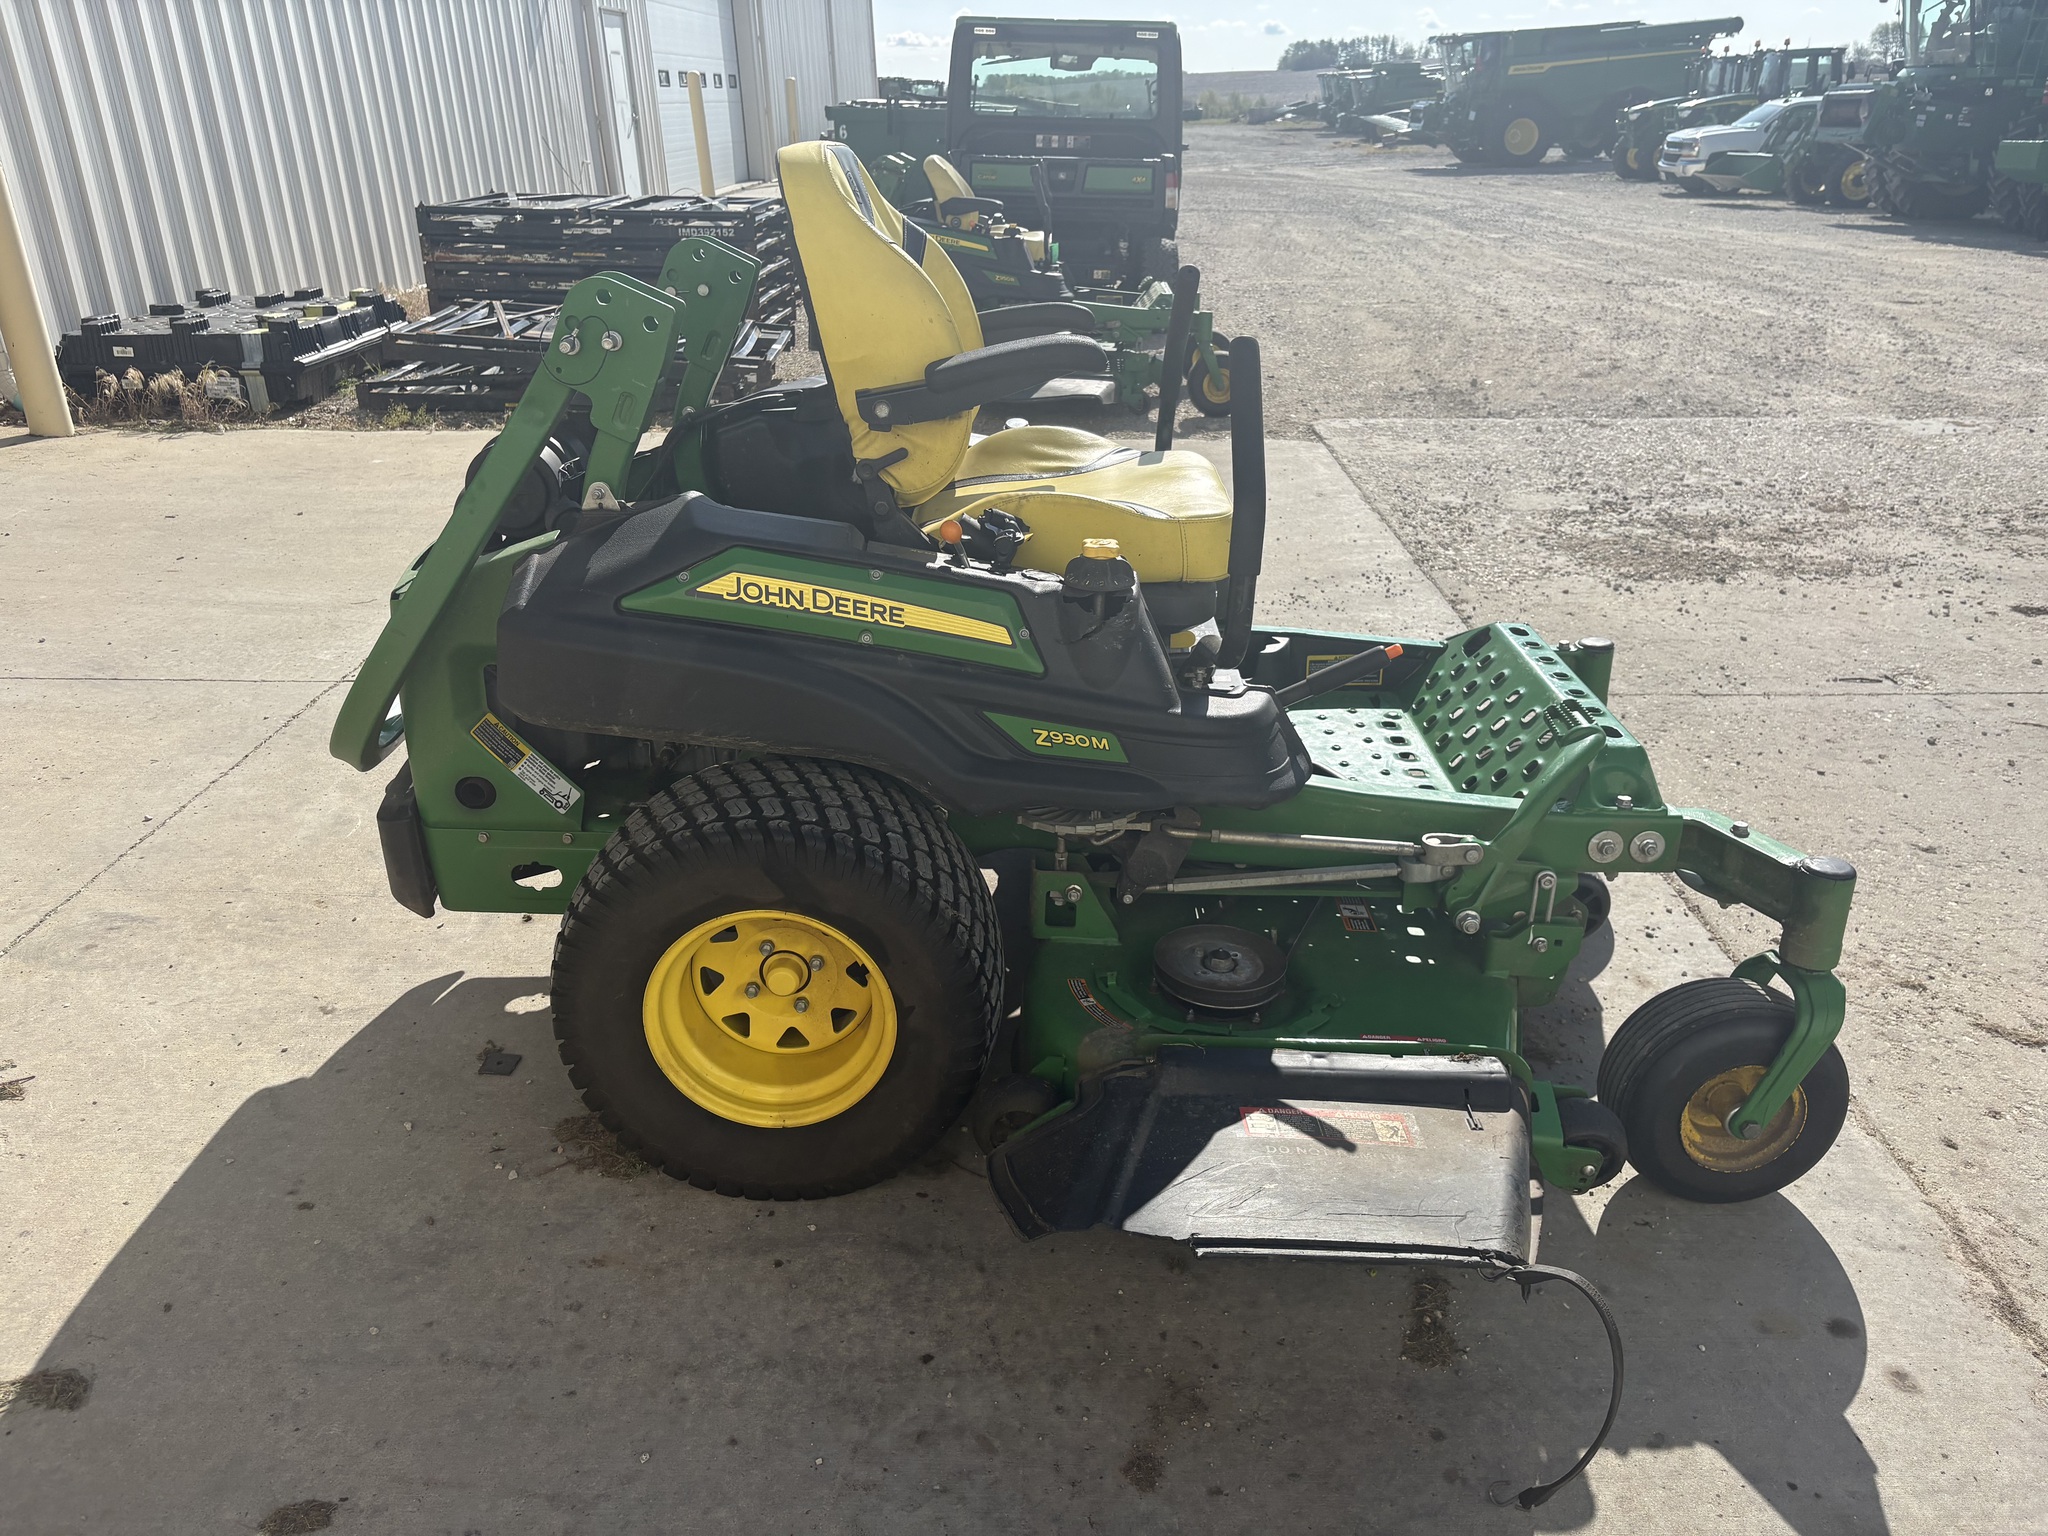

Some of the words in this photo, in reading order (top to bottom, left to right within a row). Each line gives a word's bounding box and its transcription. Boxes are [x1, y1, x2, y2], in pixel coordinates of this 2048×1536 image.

[839, 124, 848, 139] 6
[726, 577, 804, 607] JOHN
[812, 588, 905, 624] DEERE
[499, 725, 521, 747] CAUTION
[1032, 728, 1110, 751] Z930M
[1265, 1145, 1290, 1154] DO
